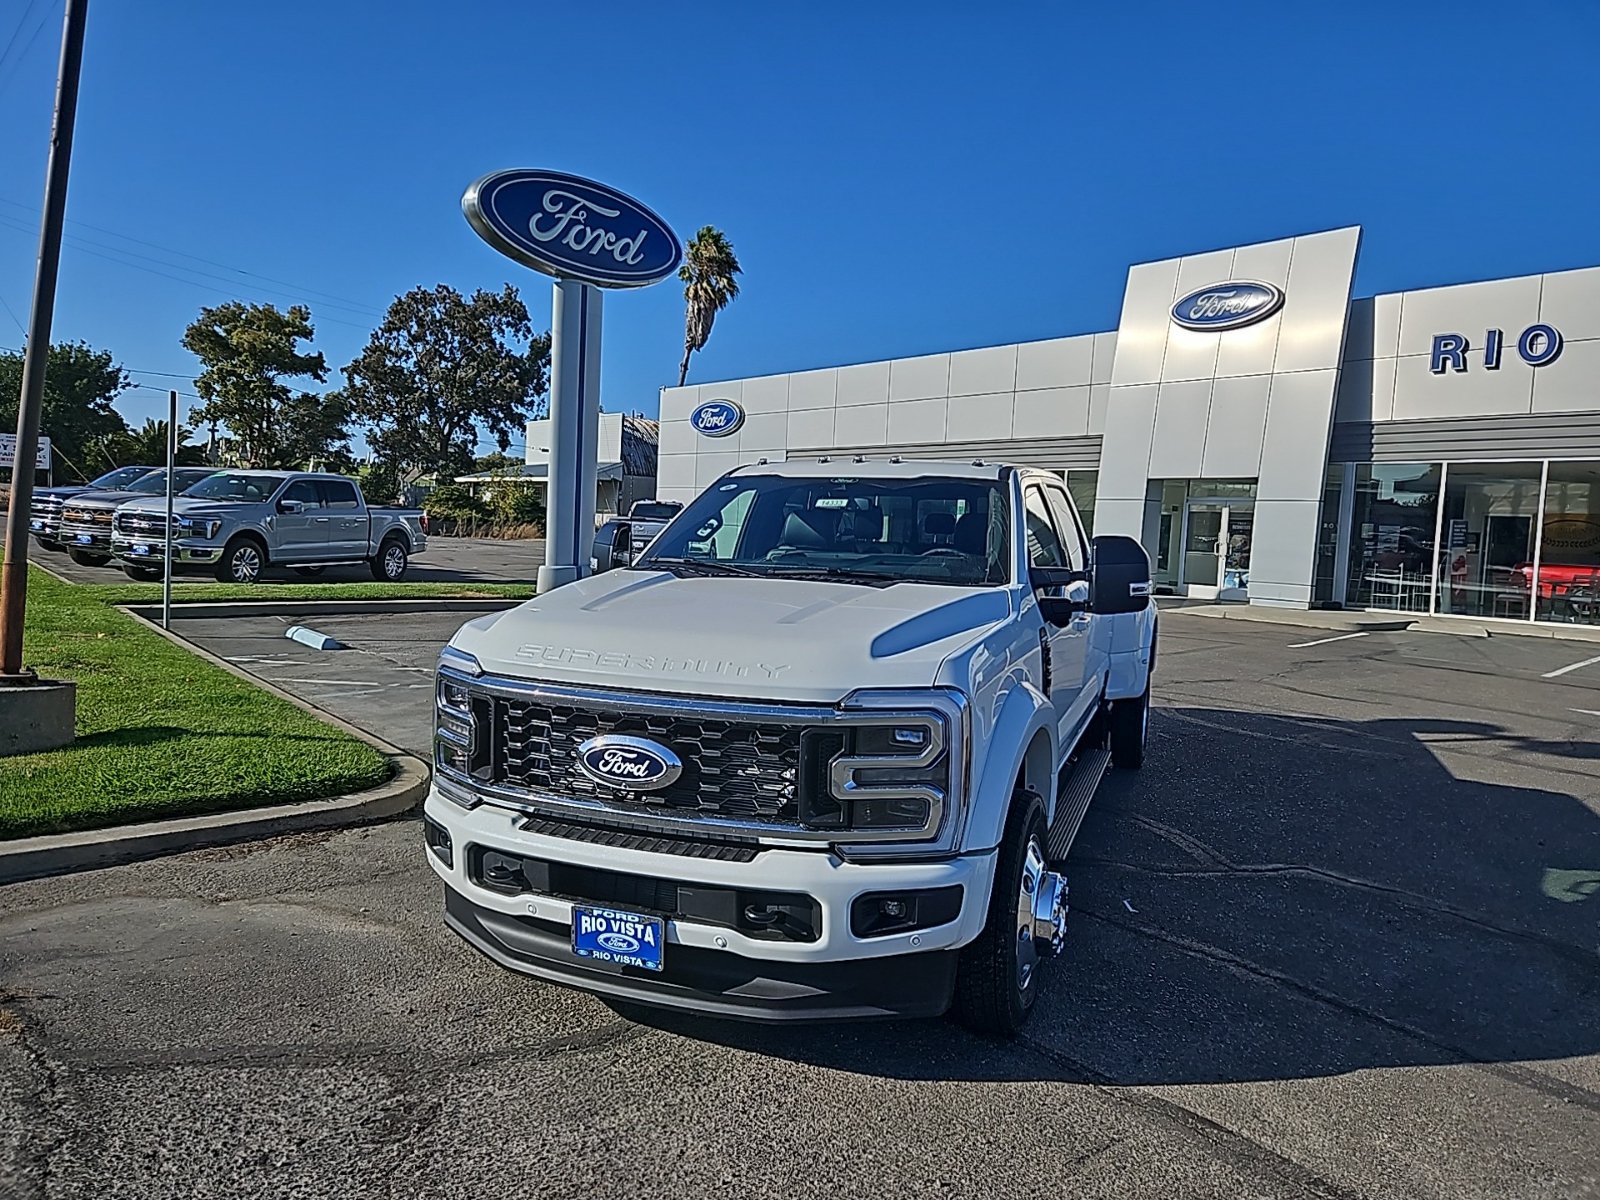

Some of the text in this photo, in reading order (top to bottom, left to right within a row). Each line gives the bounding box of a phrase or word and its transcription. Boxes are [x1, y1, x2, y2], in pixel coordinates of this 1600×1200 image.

[529, 190, 648, 265] Ford
[1189, 289, 1252, 320] Ford
[1429, 322, 1564, 375] RIO
[698, 407, 728, 428] Ford
[515, 642, 792, 680] SUPER DUTY
[598, 748, 651, 778] Ford
[580, 914, 655, 947] RIO VISTA
[592, 909, 640, 923] FORD
[607, 936, 629, 949] Ford
[592, 950, 611, 961] RIO
[613, 953, 644, 967] VISTA
